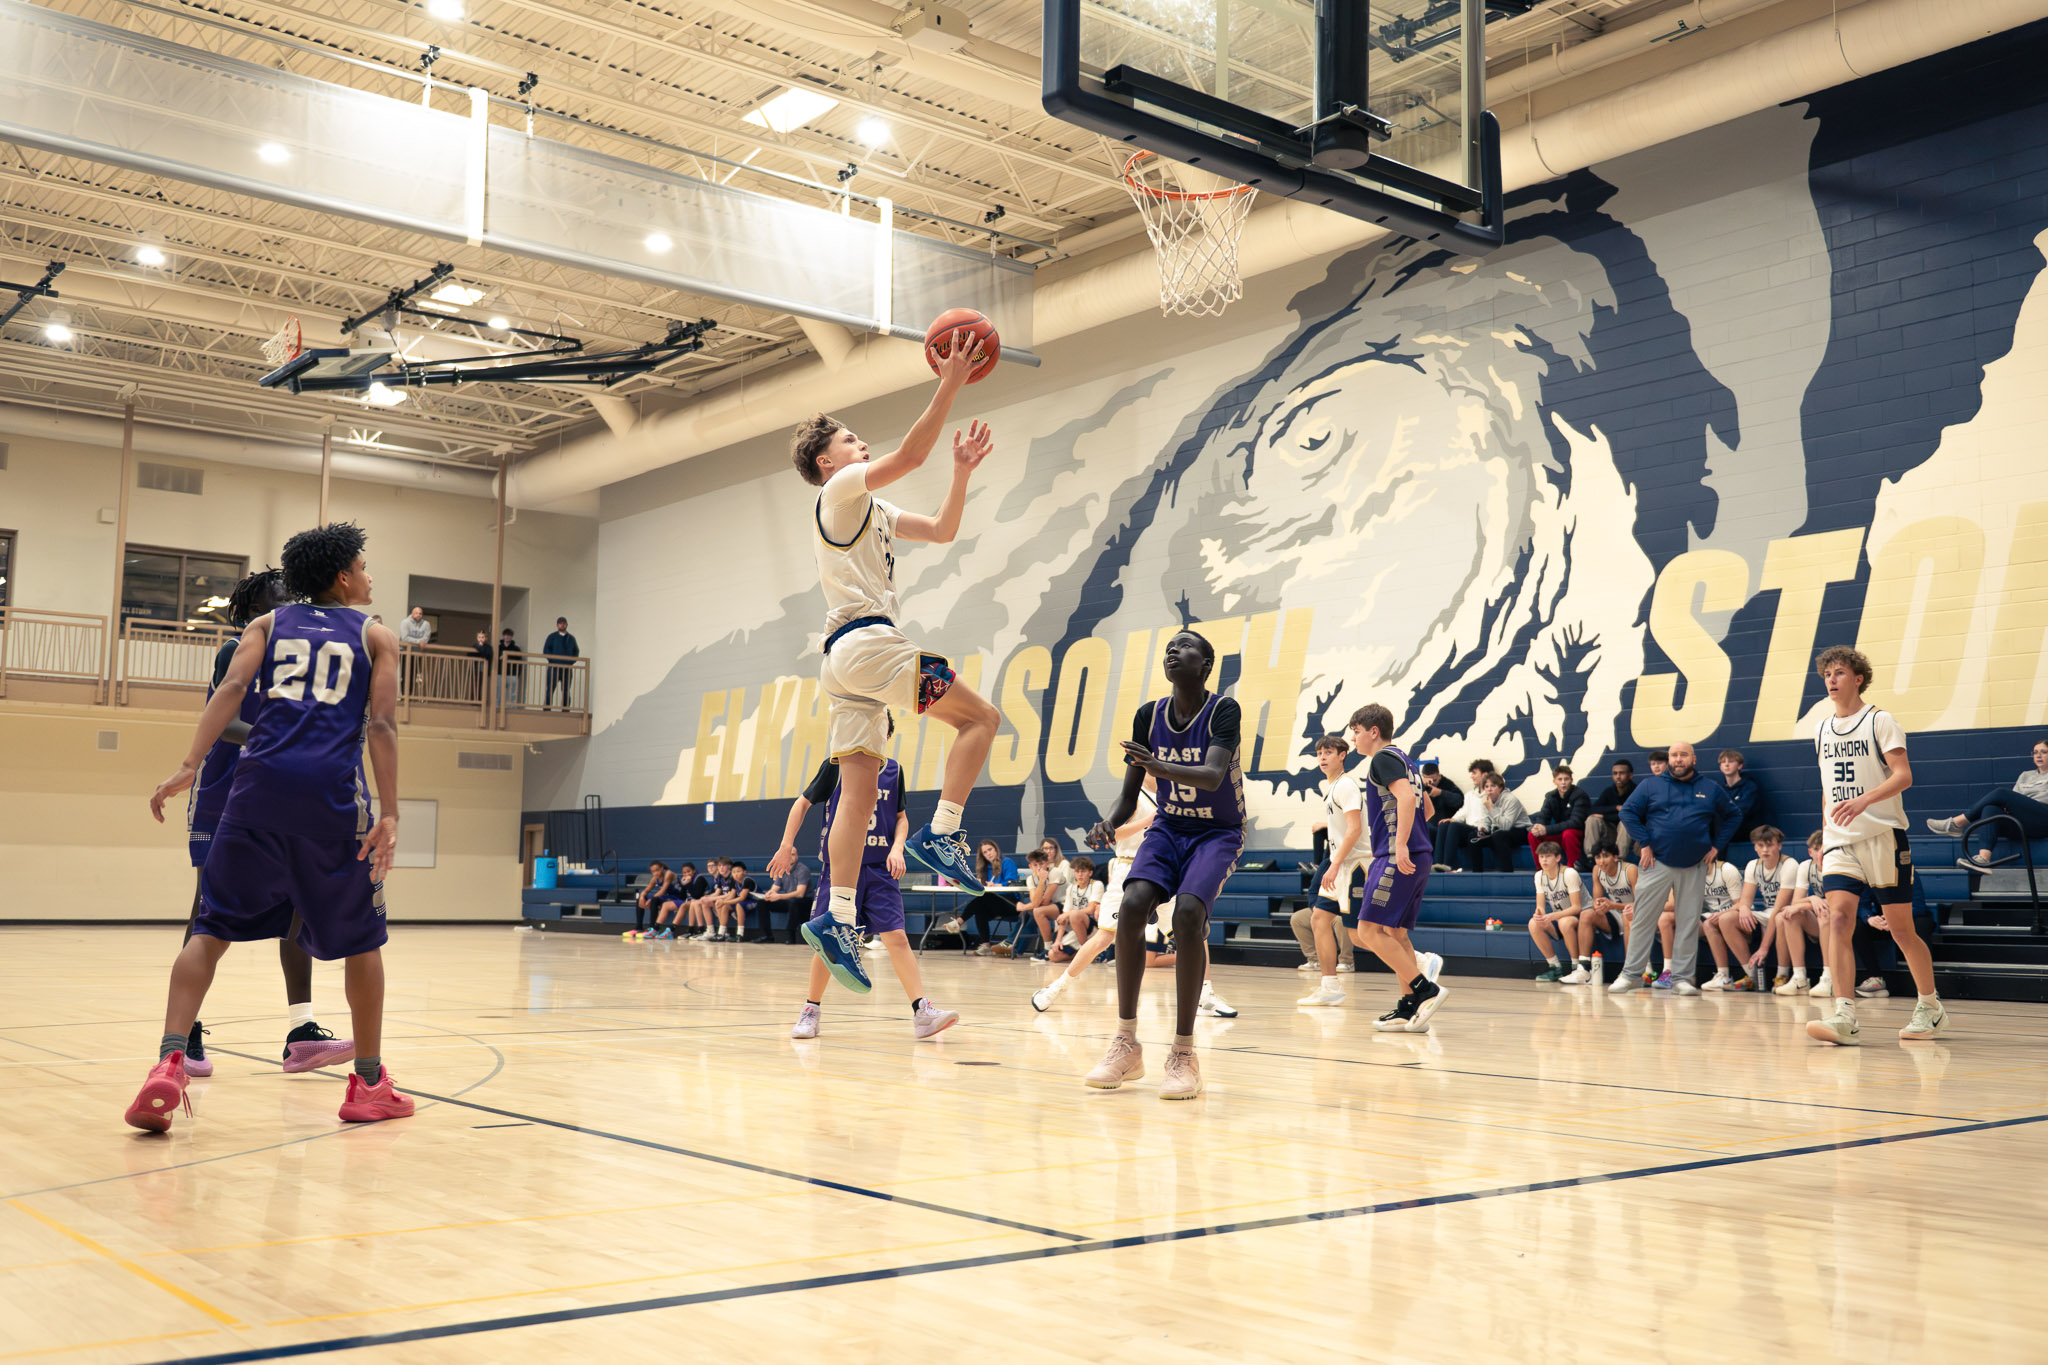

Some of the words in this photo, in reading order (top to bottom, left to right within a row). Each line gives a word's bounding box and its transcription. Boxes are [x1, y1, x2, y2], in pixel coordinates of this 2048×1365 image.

[268, 638, 355, 706] 20
[687, 653, 984, 803] ELKHN
[1157, 746, 1202, 763] EAST
[1823, 739, 1870, 760] ELKHORN
[1834, 761, 1855, 783] 35
[1169, 780, 1198, 802] 15
[1831, 785, 1865, 803] SOUTH
[1164, 801, 1214, 819] HIGH
